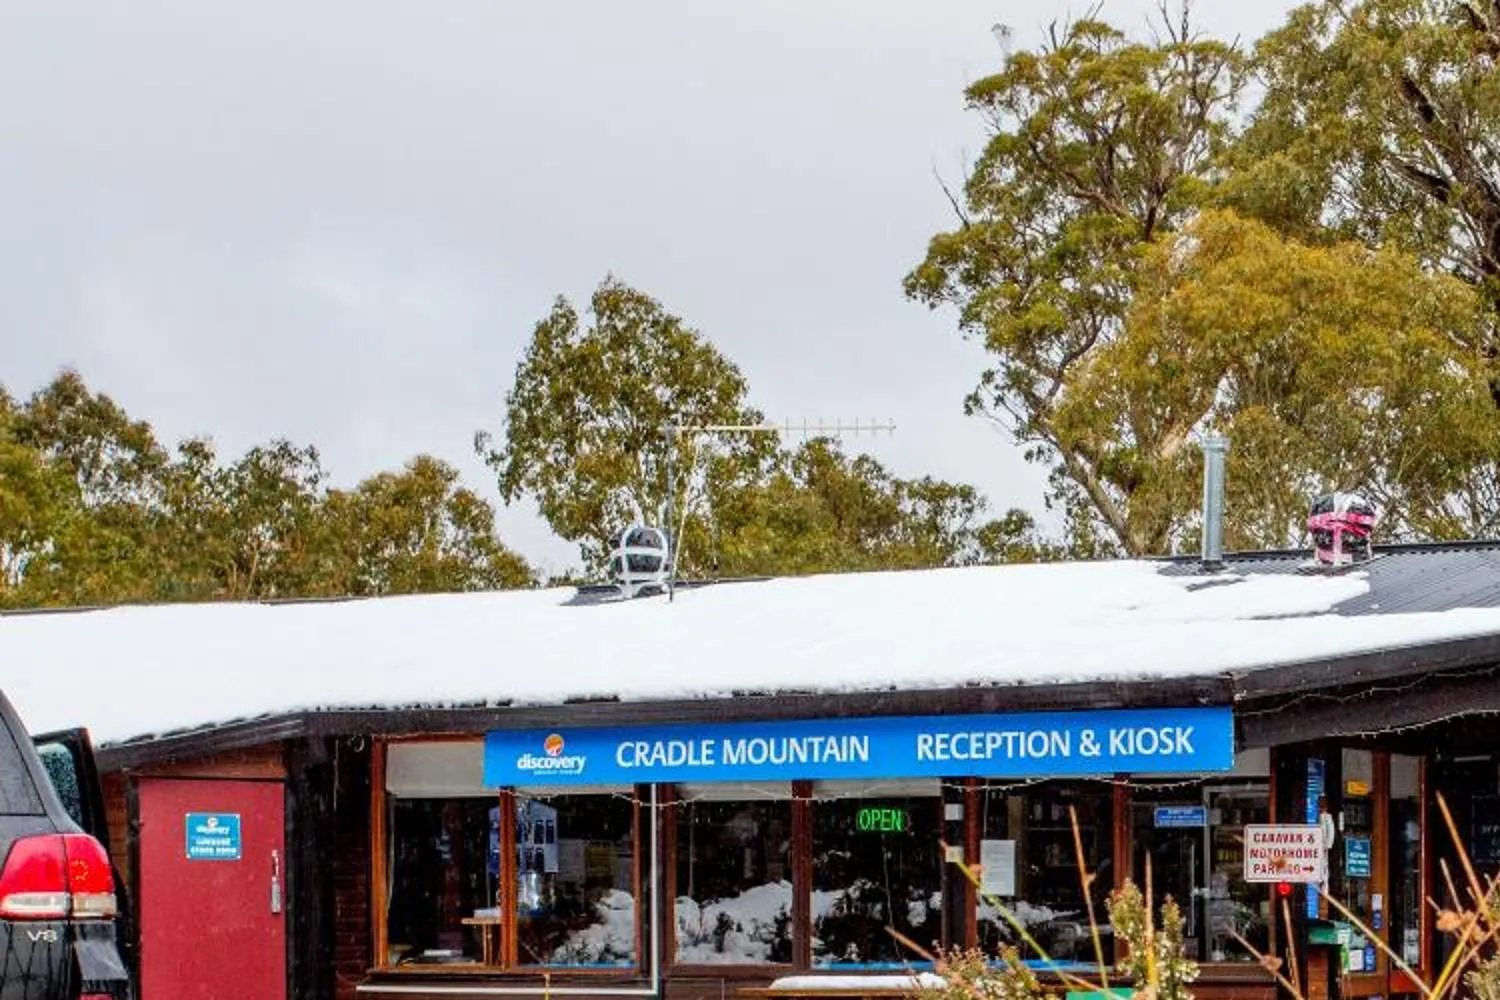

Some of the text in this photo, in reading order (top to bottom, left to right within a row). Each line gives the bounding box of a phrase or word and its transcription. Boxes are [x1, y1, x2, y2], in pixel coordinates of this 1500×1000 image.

[616, 726, 1195, 768] CRADLE MOUNTAIN RECEPTION & KIOSK
[517, 753, 586, 774] discovery
[858, 808, 902, 831] OPEN
[1253, 832, 1302, 844] CARAVAN
[1250, 847, 1318, 859] MOTORHOME
[27, 929, 57, 943] V8
